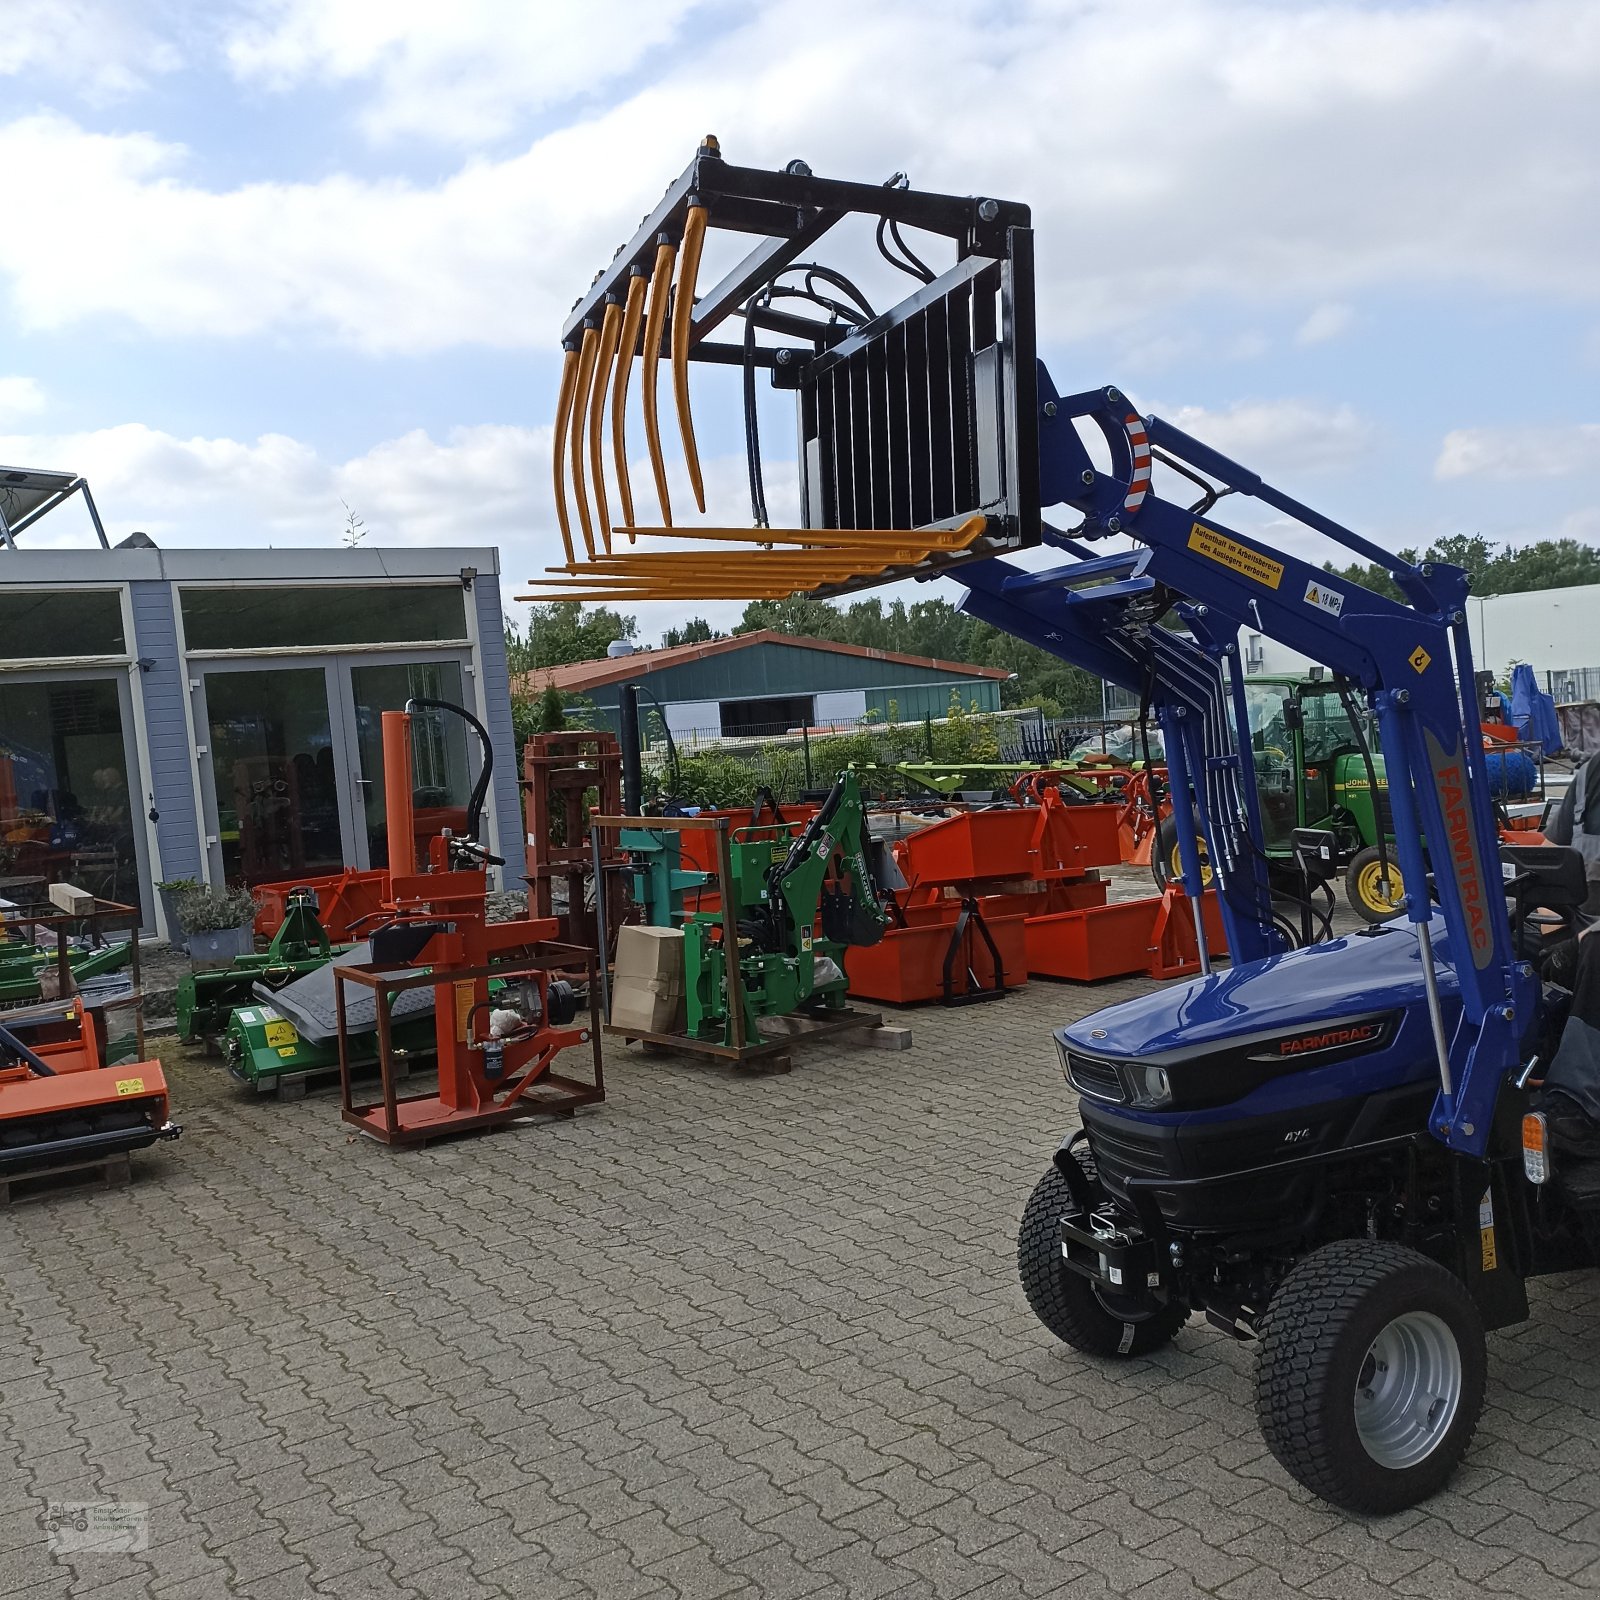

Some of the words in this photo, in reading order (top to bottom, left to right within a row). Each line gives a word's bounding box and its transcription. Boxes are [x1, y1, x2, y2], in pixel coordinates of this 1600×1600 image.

[1195, 527, 1227, 548] Aufenthalt
[1228, 543, 1236, 552] im
[1237, 548, 1281, 574] Arbeitsbereich
[1200, 541, 1211, 553] des
[1212, 547, 1242, 567] Auslegers
[1243, 563, 1270, 580] verboten
[1329, 595, 1341, 611] MPa
[1437, 766, 1487, 949] FARMTRAC
[1280, 1025, 1373, 1055] FARMTRAC
